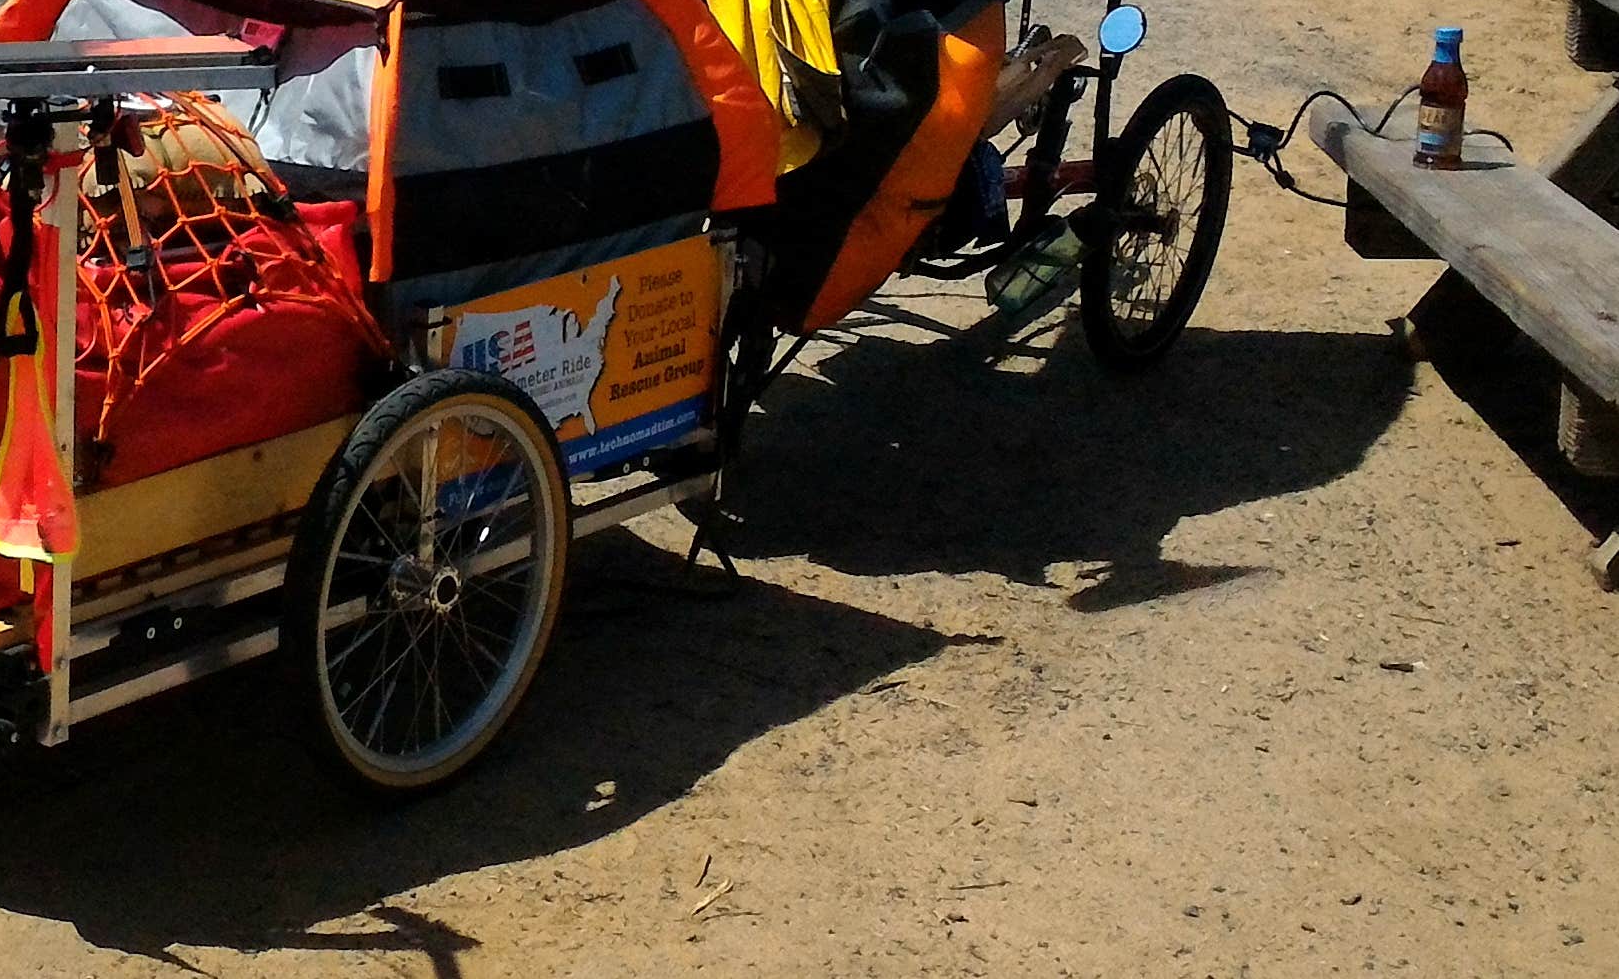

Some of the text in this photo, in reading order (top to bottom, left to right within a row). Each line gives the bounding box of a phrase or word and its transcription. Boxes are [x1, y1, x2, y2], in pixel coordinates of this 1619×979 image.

[639, 269, 682, 294] Please
[628, 290, 695, 322] Donate to
[623, 308, 696, 348] Your Local
[462, 320, 536, 375] USA
[632, 337, 686, 370] Animal
[516, 365, 557, 389] meter
[561, 355, 592, 377] Ride
[609, 372, 661, 403] Rescue
[663, 357, 705, 383] Group
[568, 409, 696, 465] www.technomadtim.com
